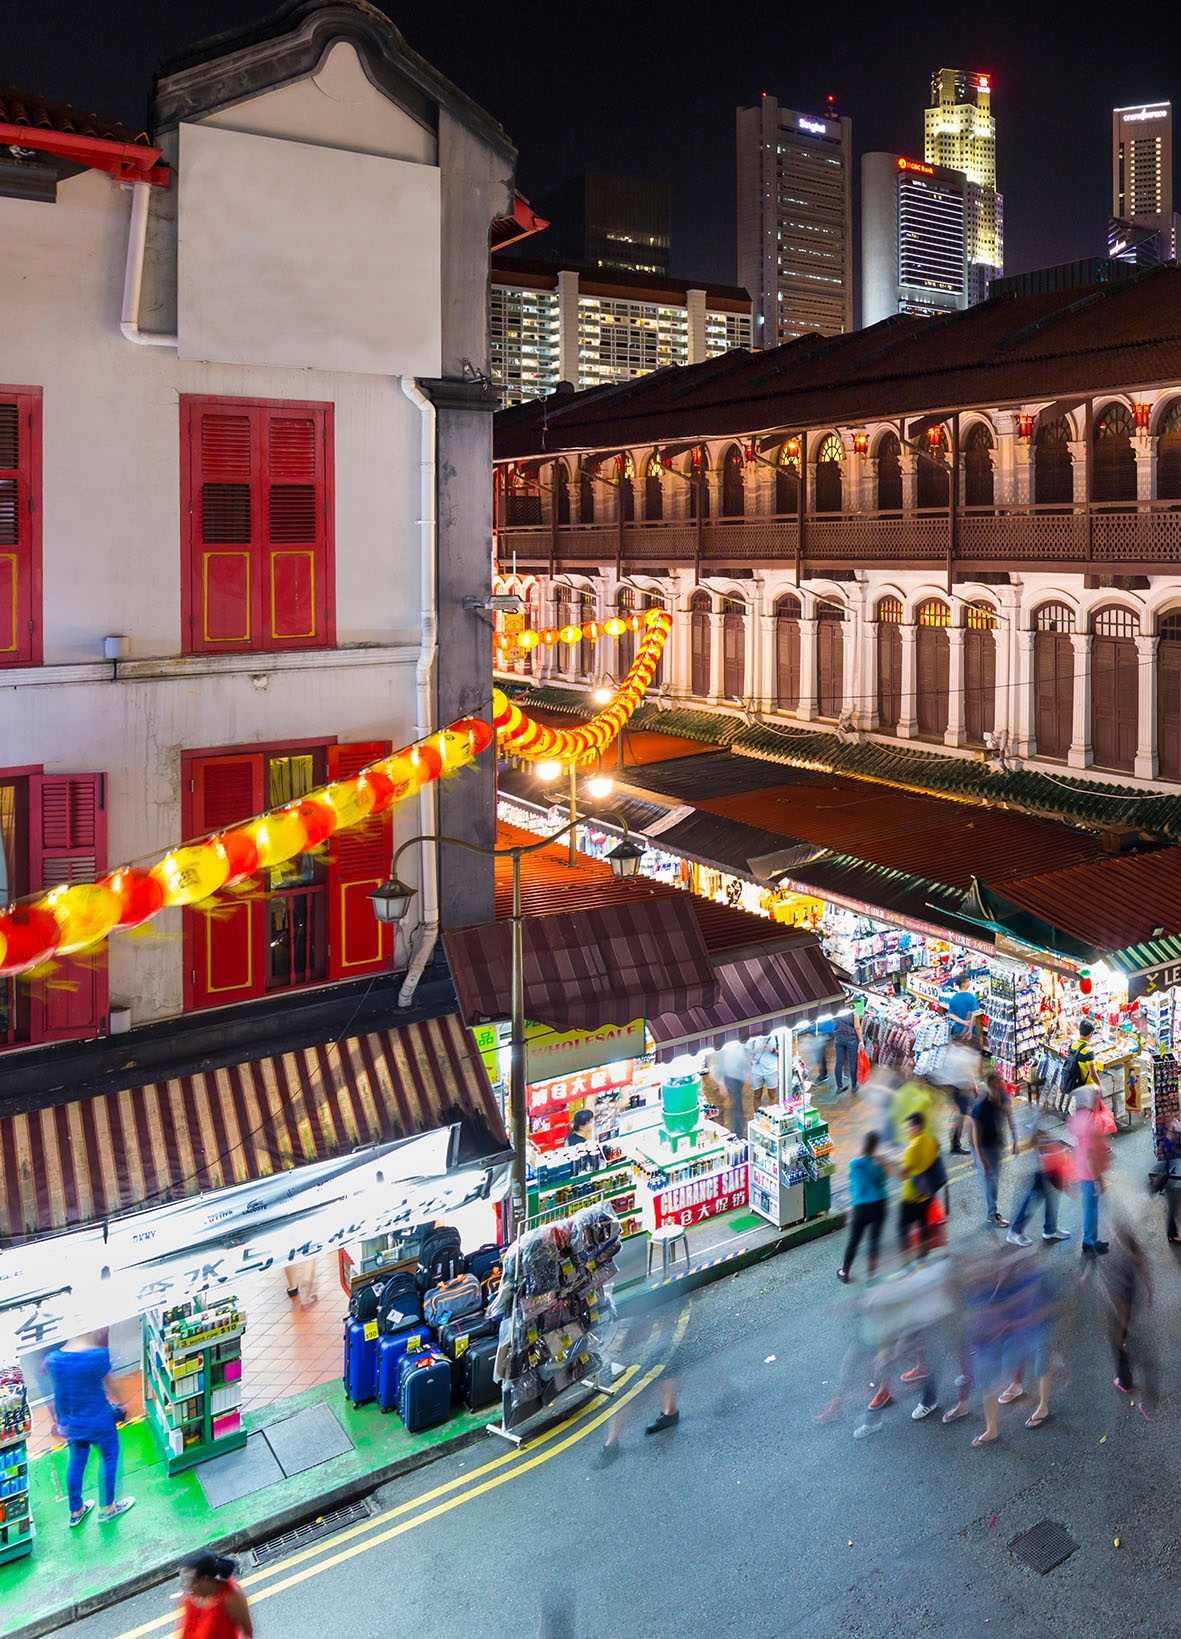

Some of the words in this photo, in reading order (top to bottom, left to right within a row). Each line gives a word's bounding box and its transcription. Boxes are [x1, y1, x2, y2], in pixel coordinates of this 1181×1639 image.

[660, 1176, 719, 1216] CLEARANCE
[721, 1167, 745, 1195] SALE
[242, 1204, 267, 1216] LACOSTE
[220, 1324, 237, 1334] $10
